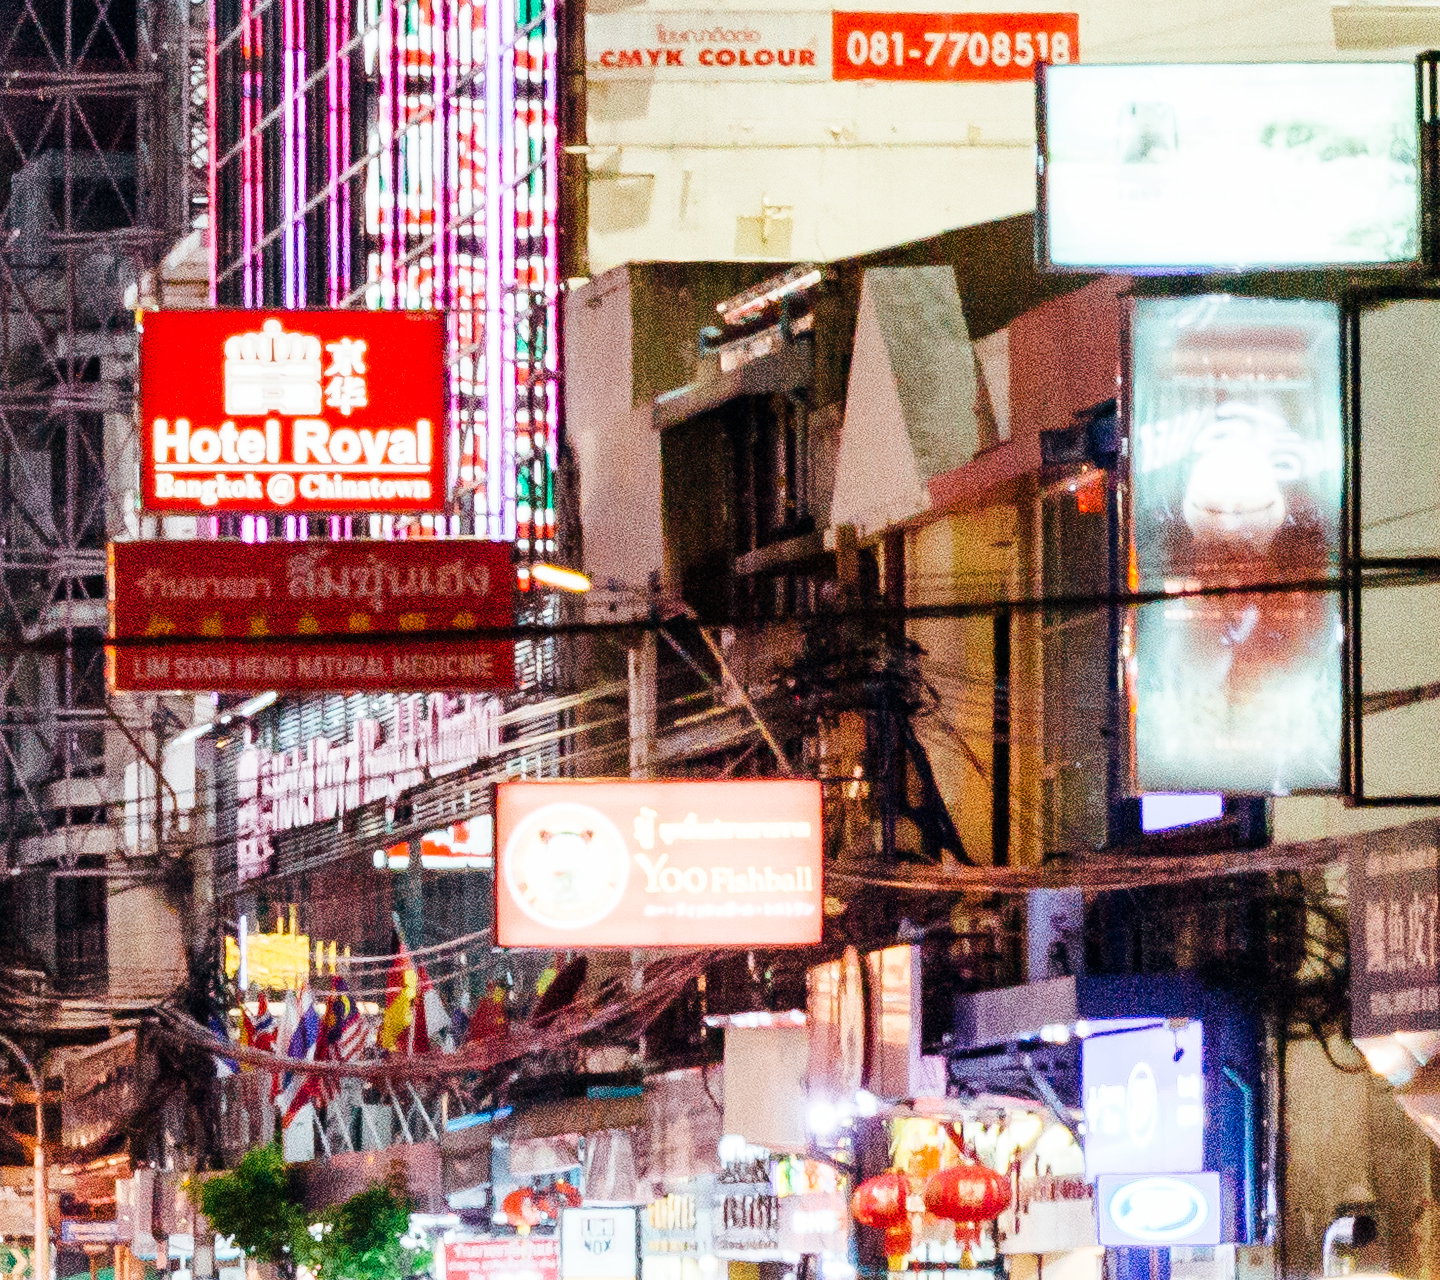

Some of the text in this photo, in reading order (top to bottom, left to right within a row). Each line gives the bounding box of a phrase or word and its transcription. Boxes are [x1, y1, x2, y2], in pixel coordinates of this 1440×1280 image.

[698, 48, 817, 67] COLOUR
[846, 30, 1070, 67] 081-7708518
[152, 419, 432, 466] Hotel Royal
[156, 473, 432, 504] Bangkok @ Chinatown
[297, 655, 387, 680] NATURAL
[393, 654, 494, 679] MEDICINE
